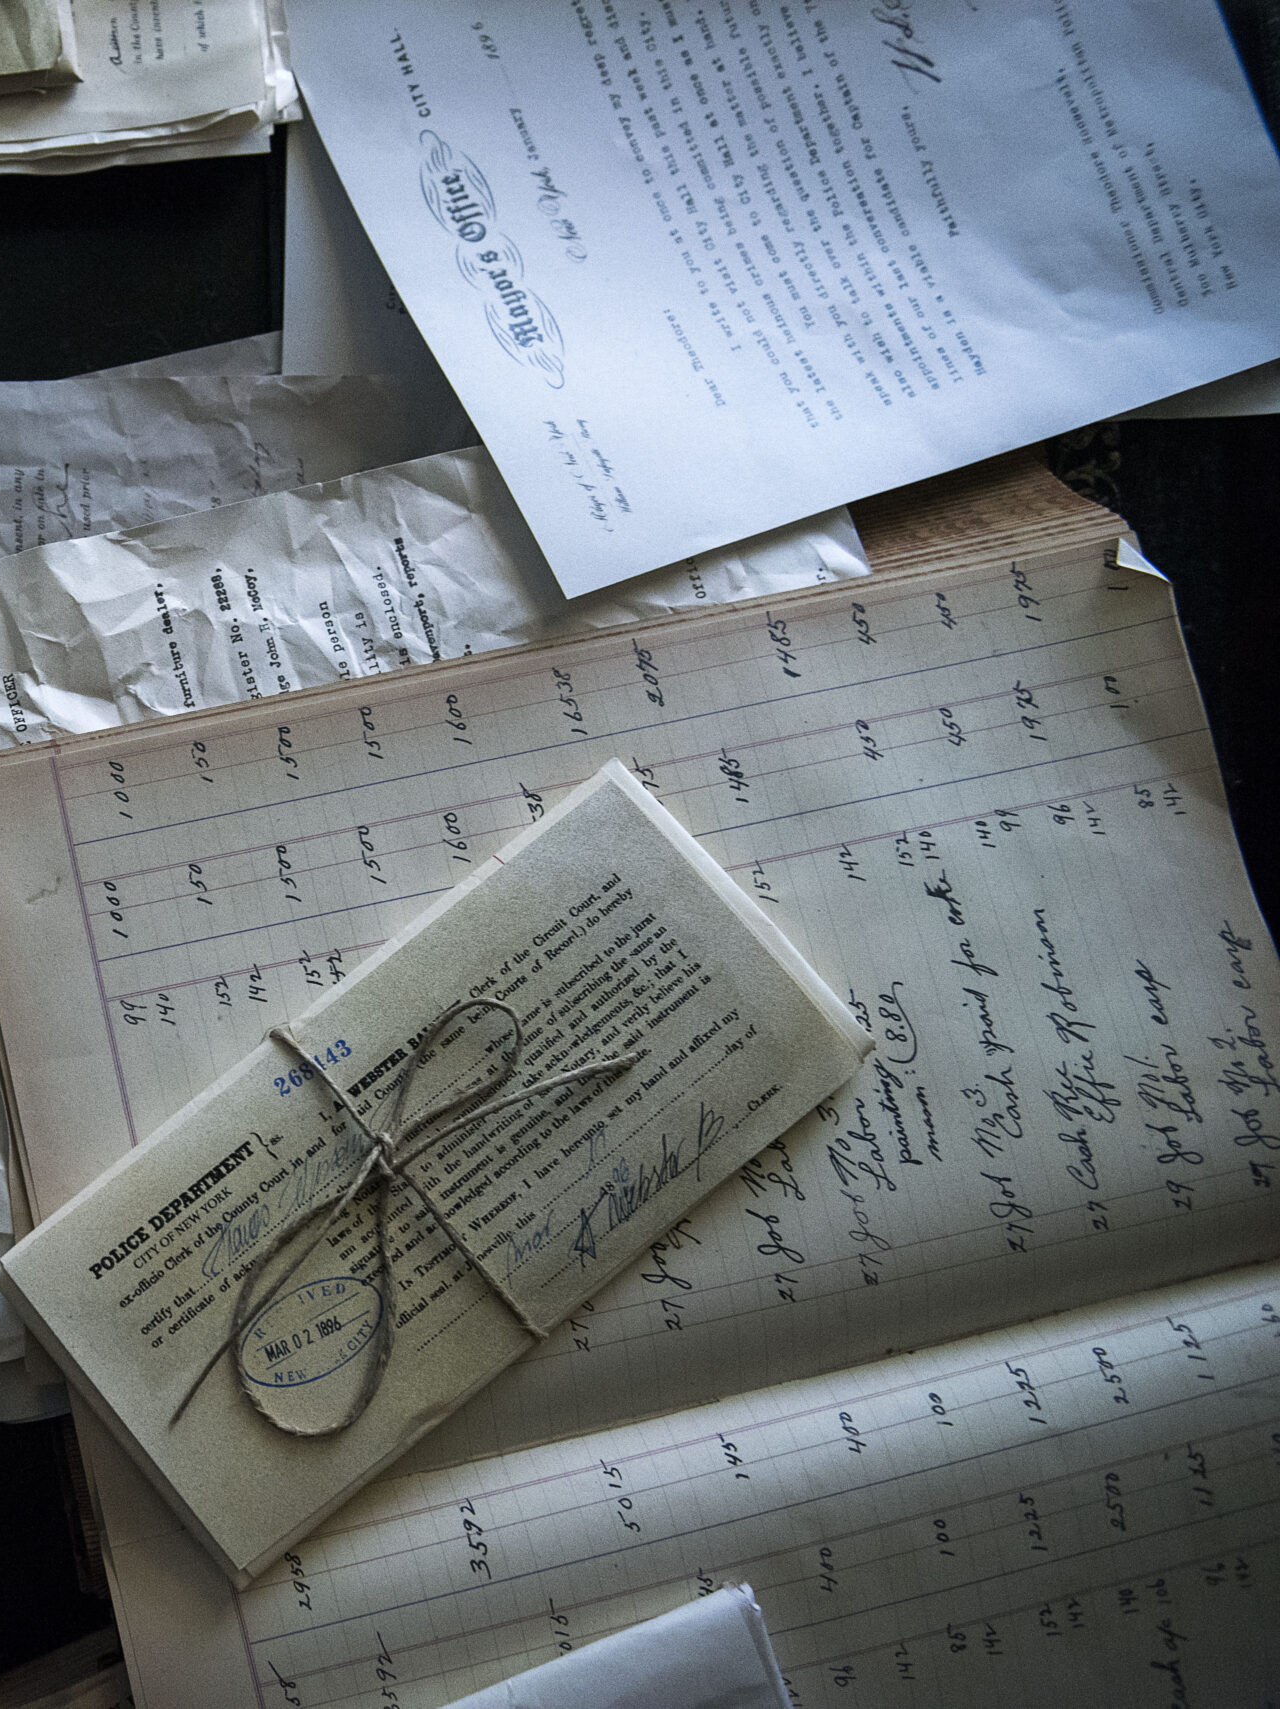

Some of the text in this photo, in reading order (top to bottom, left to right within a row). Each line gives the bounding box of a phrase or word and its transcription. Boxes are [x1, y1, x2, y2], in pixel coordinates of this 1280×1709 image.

[390, 28, 431, 118] CITY HALL.
[593, 53, 612, 86] deep
[608, 93, 622, 110] my
[509, 108, 539, 161] January
[618, 116, 644, 163] convey
[642, 168, 653, 185] to
[901, 105, 959, 237] Faithfully yours,
[652, 192, 672, 222] once
[442, 169, 544, 347] Mayor's Office,
[669, 229, 683, 244] at
[681, 250, 702, 274] you
[697, 280, 709, 295] to
[708, 301, 733, 338] write
[662, 308, 726, 407] Dear Theodore:
[394, 537, 417, 588] reports
[244, 568, 262, 612] McCoy,
[372, 565, 403, 640] enclosed.
[154, 583, 195, 708] furniture dealer,
[230, 618, 244, 644] No.
[318, 600, 344, 653] person
[266, 637, 281, 668] John
[2, 673, 28, 733] OFFICER
[469, 873, 621, 998] Clerk of the Circuit Court, and
[949, 932, 999, 978] for
[248, 963, 268, 1003] 142
[119, 999, 147, 1026] 99
[156, 992, 177, 1027] 140
[1033, 902, 1123, 1125] Effie Robinson
[347, 1049, 407, 1097] WEBSTER
[874, 1057, 923, 1166] painting
[987, 1066, 1024, 1140] Cash
[848, 1097, 896, 1192] Labor
[89, 1141, 253, 1279] POLICE DEPARTMENT
[119, 1121, 347, 1308] ex-officio Clerk of the County Court in and for
[988, 1176, 1032, 1226] Job
[132, 1187, 232, 1269] CITY OF NEW YORK
[264, 1340, 290, 1362] MAR
[316, 1316, 342, 1337] 1896
